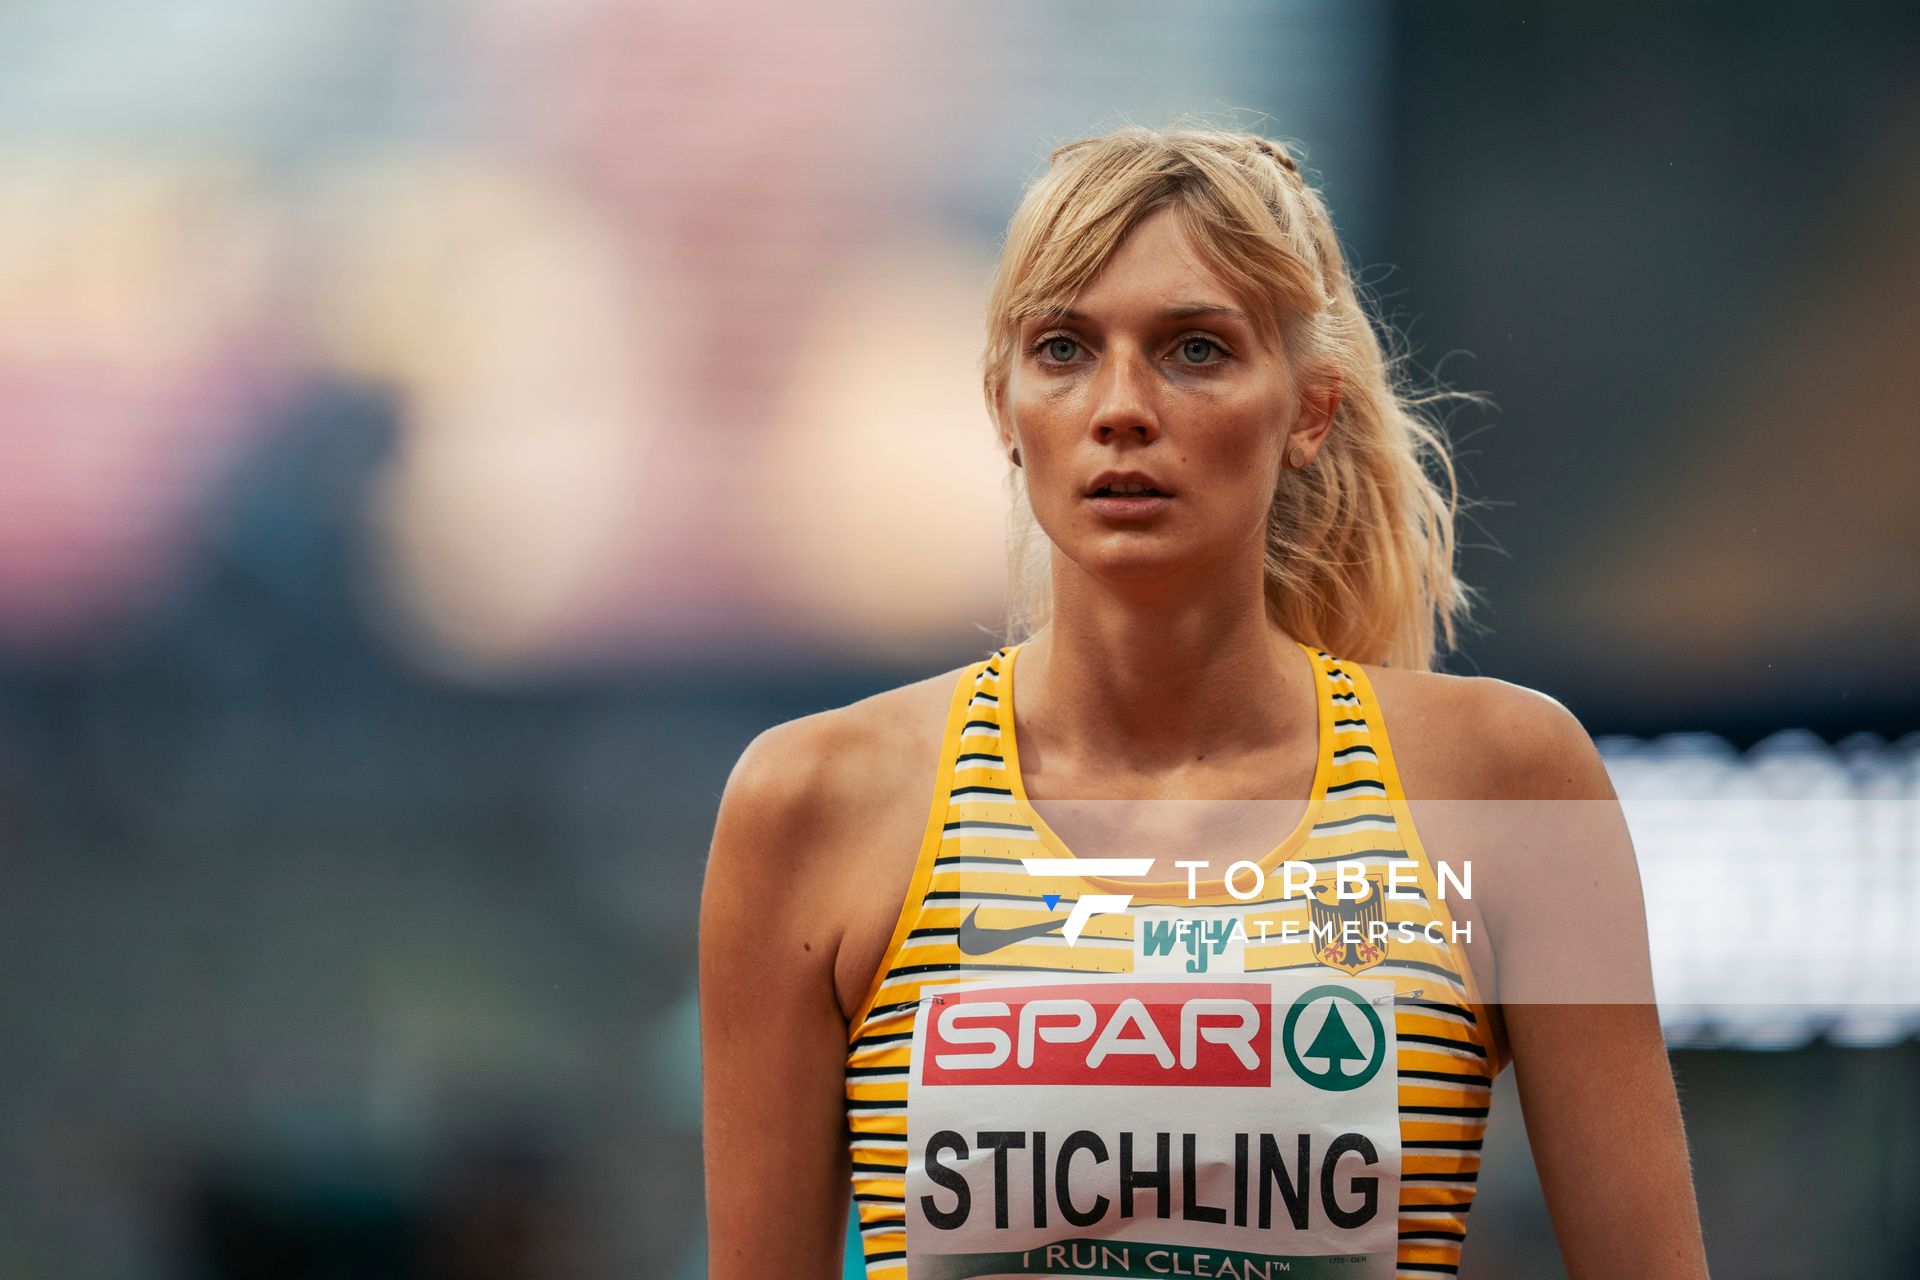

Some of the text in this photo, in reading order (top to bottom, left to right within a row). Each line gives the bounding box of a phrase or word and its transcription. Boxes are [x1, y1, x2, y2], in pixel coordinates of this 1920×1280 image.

[935, 997, 1261, 1070] SPAR
[920, 1130, 1379, 1230] STICHLING
[1046, 1243, 1130, 1271] RUN
